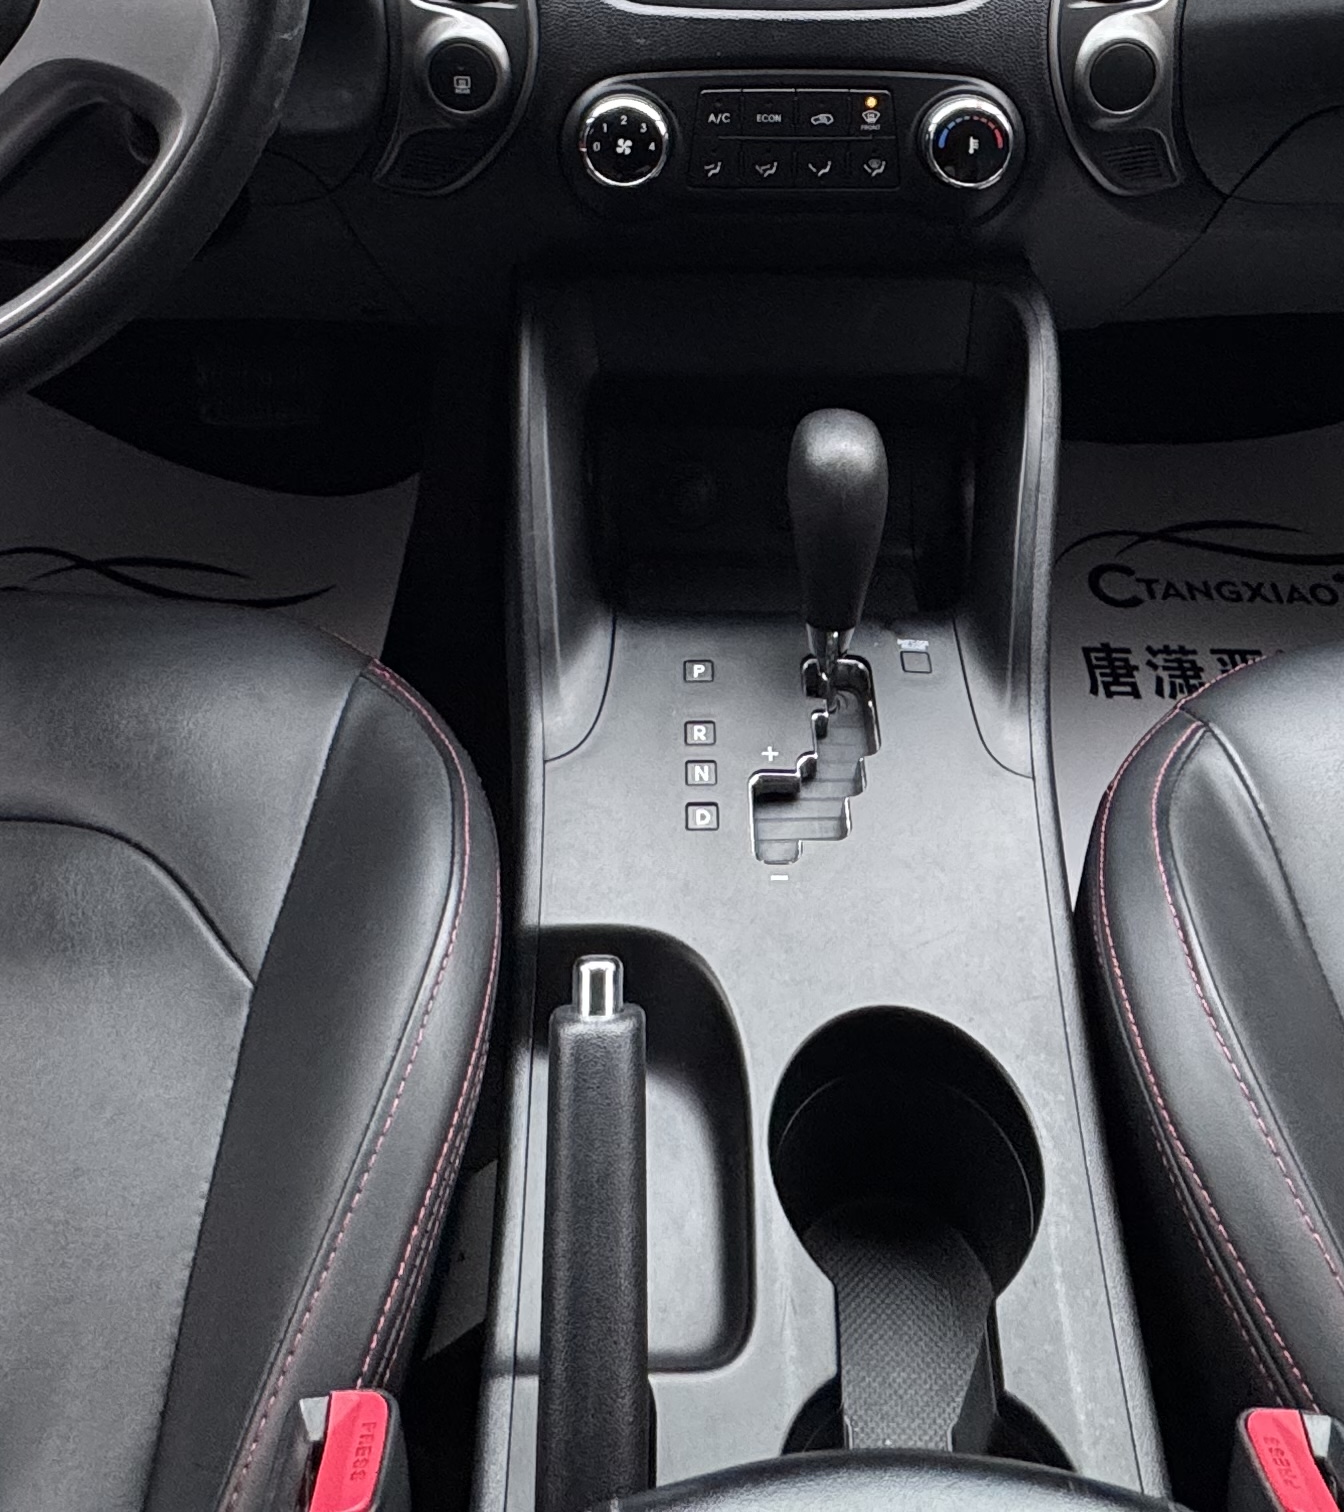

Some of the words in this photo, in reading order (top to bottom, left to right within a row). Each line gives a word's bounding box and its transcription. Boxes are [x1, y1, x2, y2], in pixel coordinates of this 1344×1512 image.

[620, 115, 628, 125] 2
[708, 113, 731, 124] A/C
[756, 114, 782, 123] ECON
[602, 123, 608, 133] 1
[639, 122, 648, 132] 3
[592, 141, 601, 152] 0
[648, 141, 656, 151] 4
[693, 664, 706, 678] P
[1081, 642, 1285, 700] 唐潇
[693, 725, 707, 741] R
[694, 766, 709, 782] N
[695, 808, 711, 825] D
